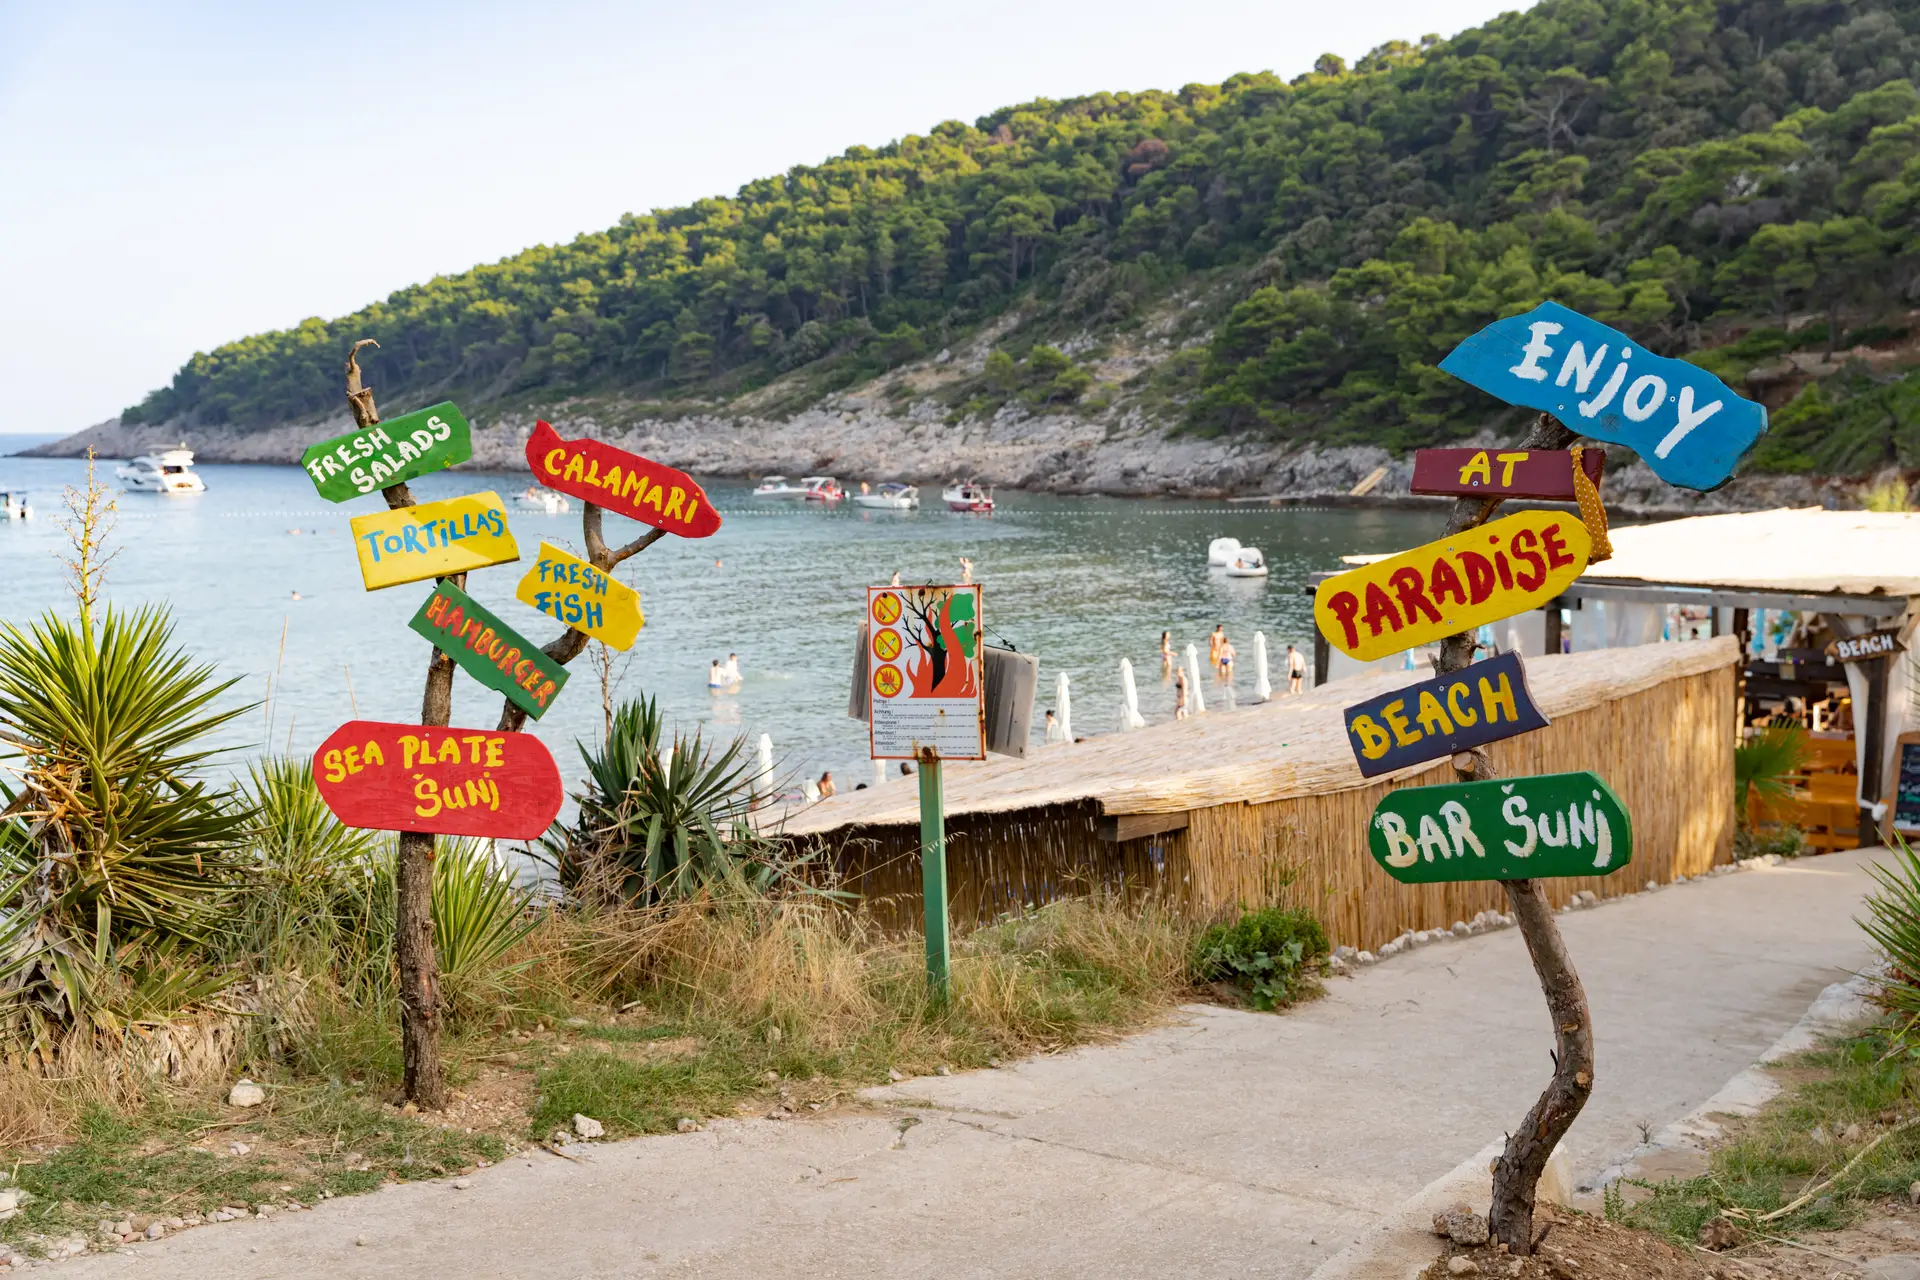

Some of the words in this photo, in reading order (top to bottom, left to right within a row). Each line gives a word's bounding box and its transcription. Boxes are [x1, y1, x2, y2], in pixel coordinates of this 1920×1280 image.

[306, 427, 393, 484] FRESH
[351, 415, 452, 494] SALADS
[1459, 450, 1529, 488] AT
[537, 559, 607, 596] FRESH
[425, 593, 557, 709] HAMBURGER
[1837, 634, 1893, 658] BEACH
[1350, 671, 1519, 760] BEACH
[323, 740, 385, 783] SEA
[397, 735, 505, 769] PLATE
[1374, 800, 1486, 868] BAR
